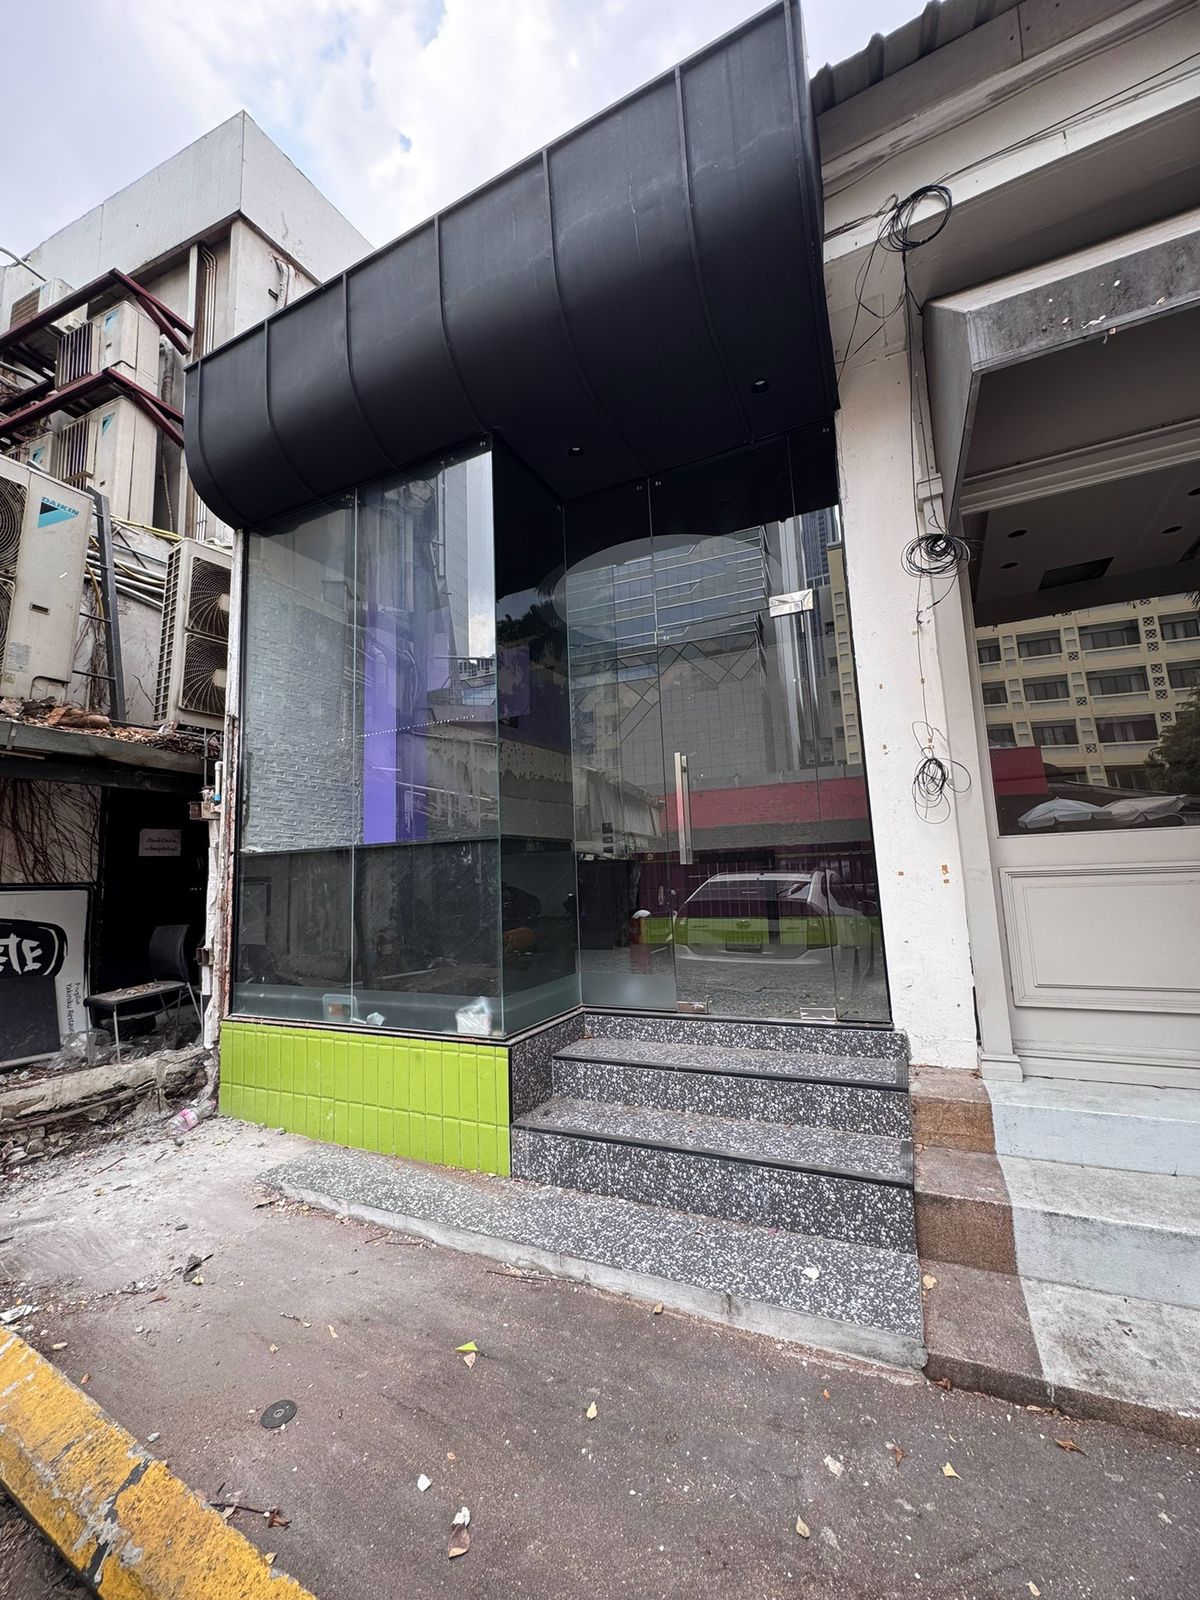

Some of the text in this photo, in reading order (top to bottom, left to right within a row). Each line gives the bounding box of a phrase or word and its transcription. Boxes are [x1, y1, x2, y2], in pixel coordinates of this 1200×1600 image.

[41, 496, 80, 516] DAIKIN
[65, 982, 75, 1033] Yakiniku Restaur
